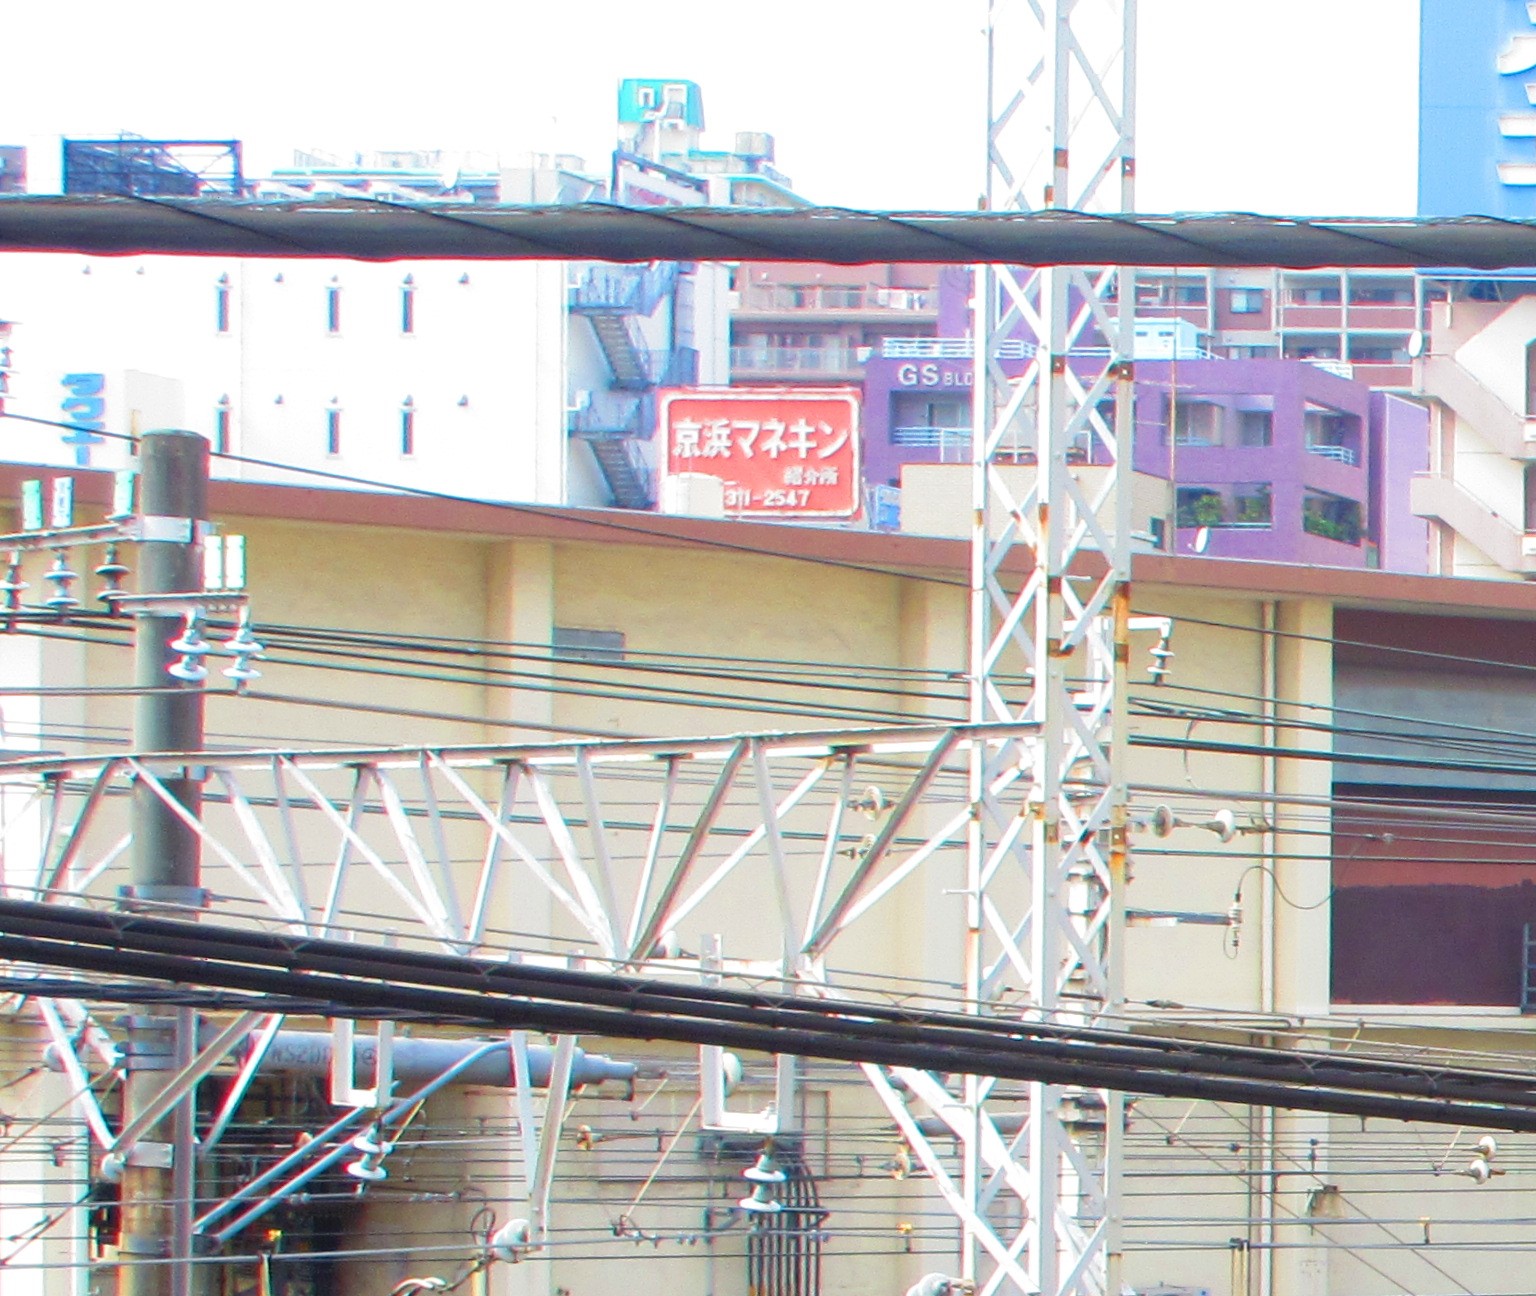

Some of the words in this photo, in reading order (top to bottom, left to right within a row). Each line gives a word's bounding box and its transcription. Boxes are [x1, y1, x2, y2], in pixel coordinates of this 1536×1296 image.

[898, 363, 940, 386] GS
[944, 372, 973, 386] BLD
[672, 418, 849, 459] 京浜マネキン
